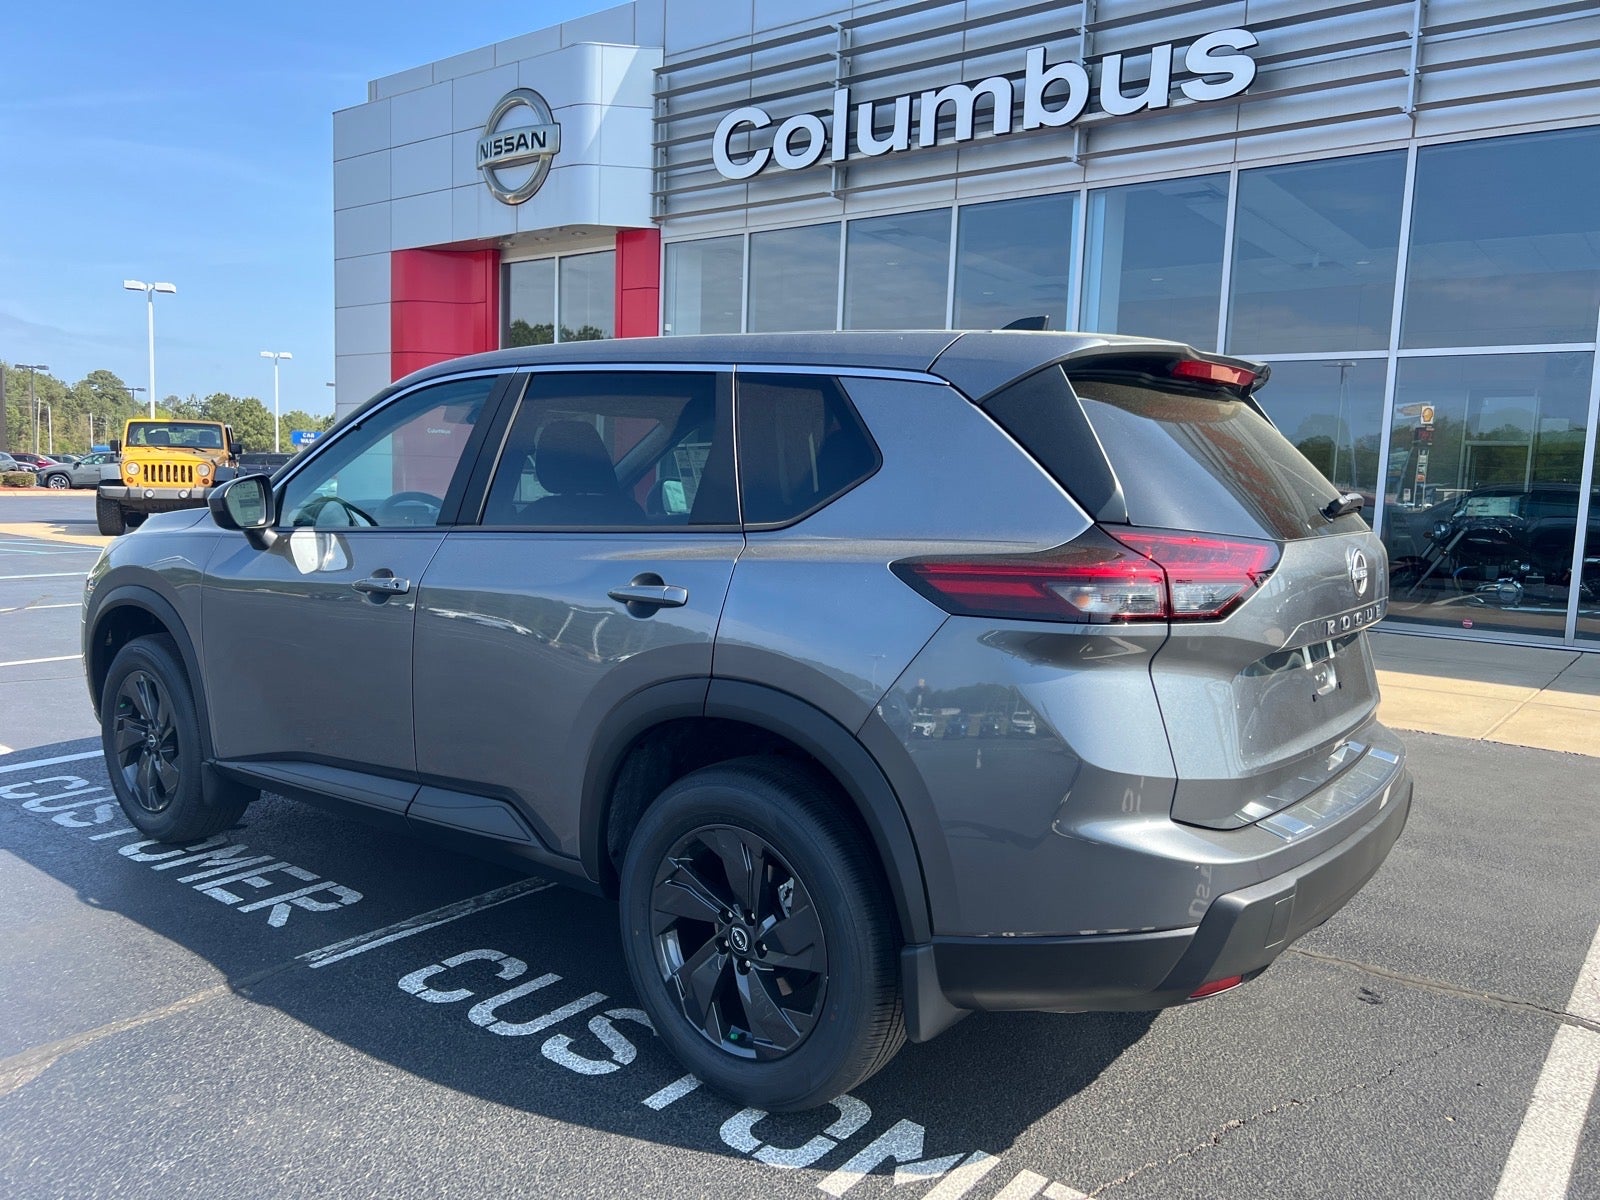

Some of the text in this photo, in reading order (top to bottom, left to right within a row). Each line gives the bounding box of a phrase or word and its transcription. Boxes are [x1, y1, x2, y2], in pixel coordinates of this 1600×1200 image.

[712, 27, 1259, 180] Columbus
[479, 130, 547, 162] NISSAN
[1325, 604, 1382, 636] ROGUE
